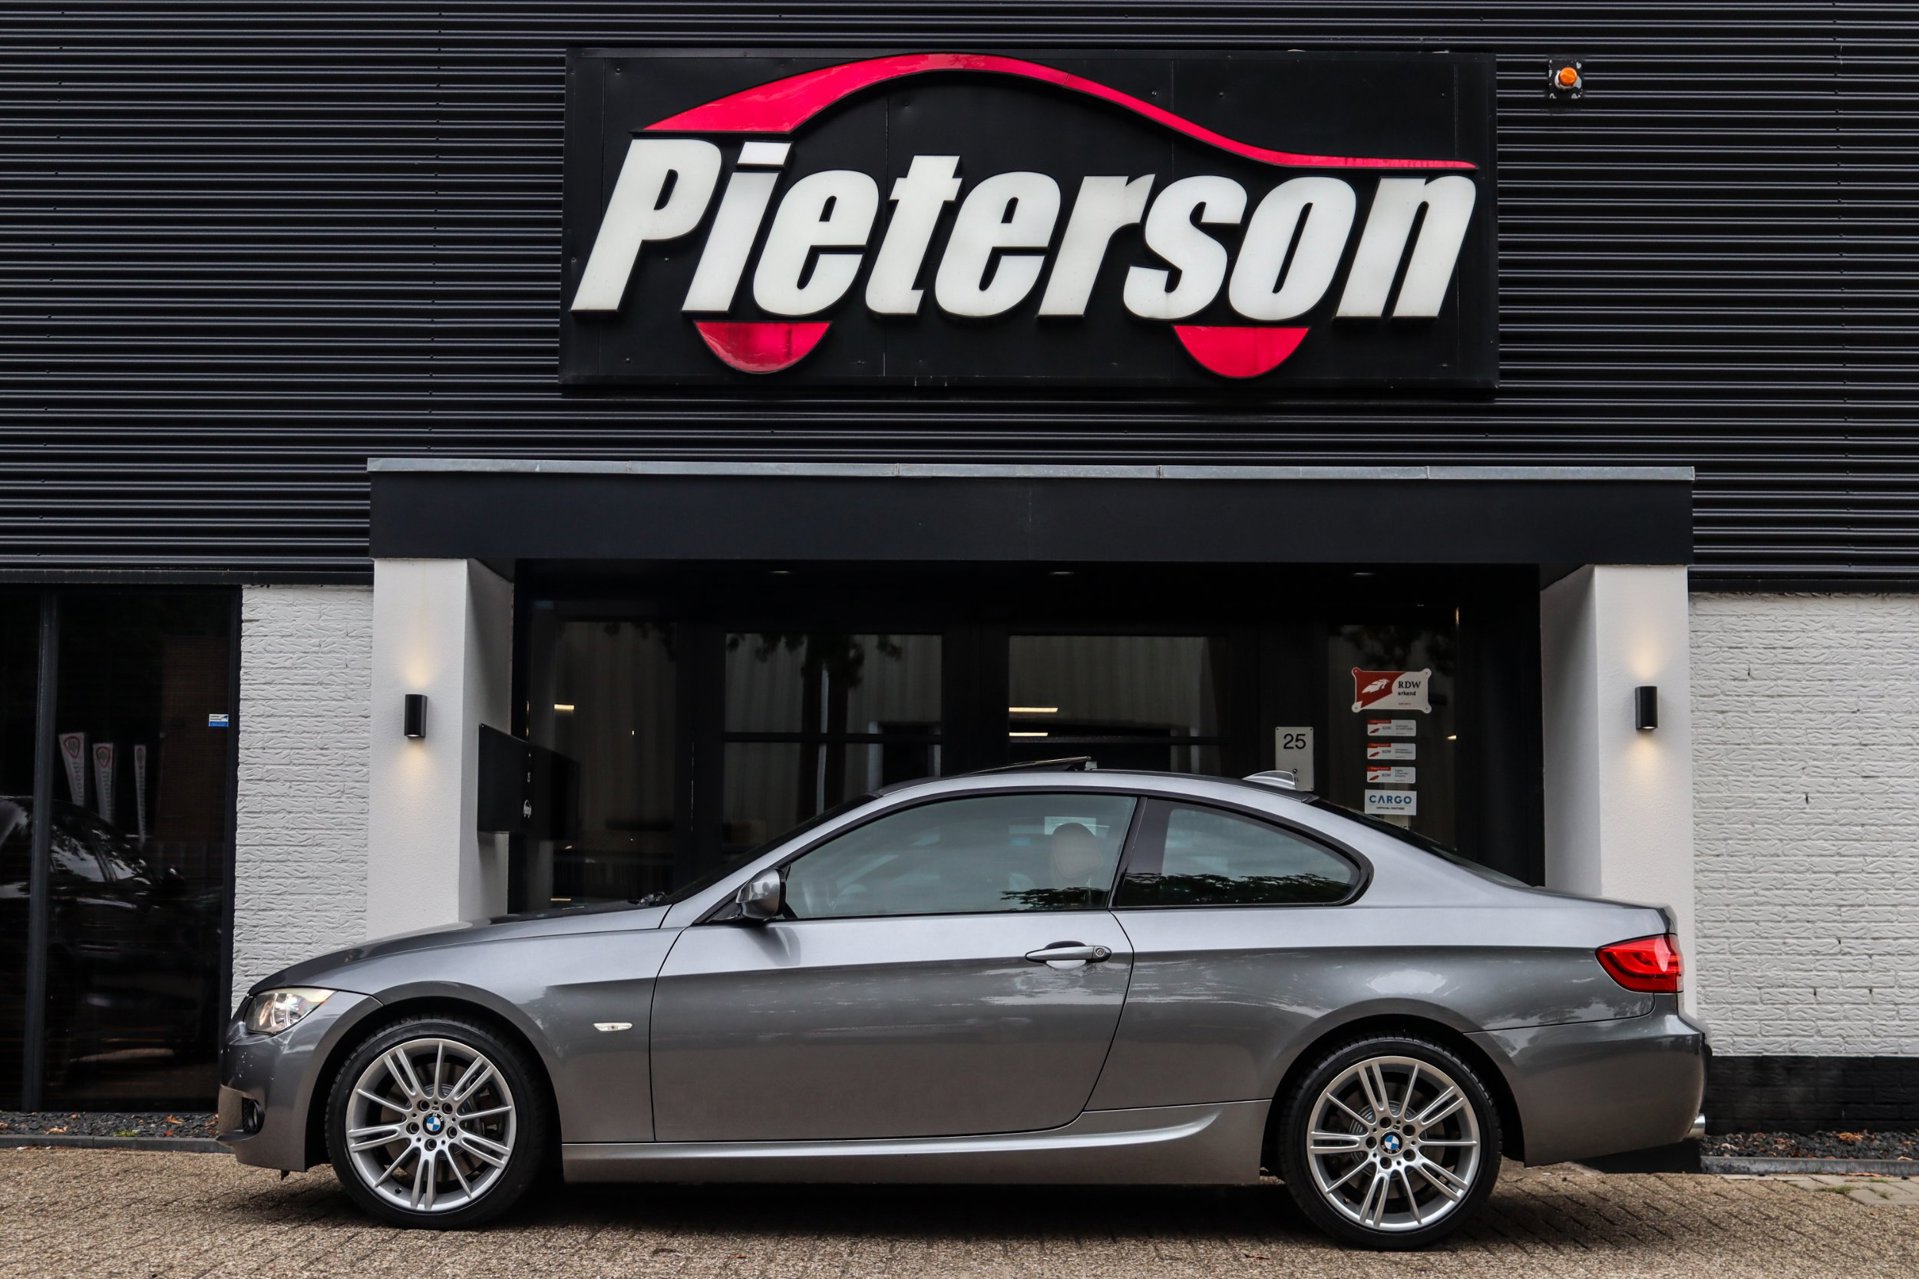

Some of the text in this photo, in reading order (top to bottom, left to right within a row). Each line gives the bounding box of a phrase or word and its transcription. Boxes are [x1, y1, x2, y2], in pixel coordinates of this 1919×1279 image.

[569, 137, 1477, 321] Pieterson
[1398, 681, 1421, 689] RDW
[1283, 733, 1306, 750] 25
[1369, 795, 1412, 804] CARGO
